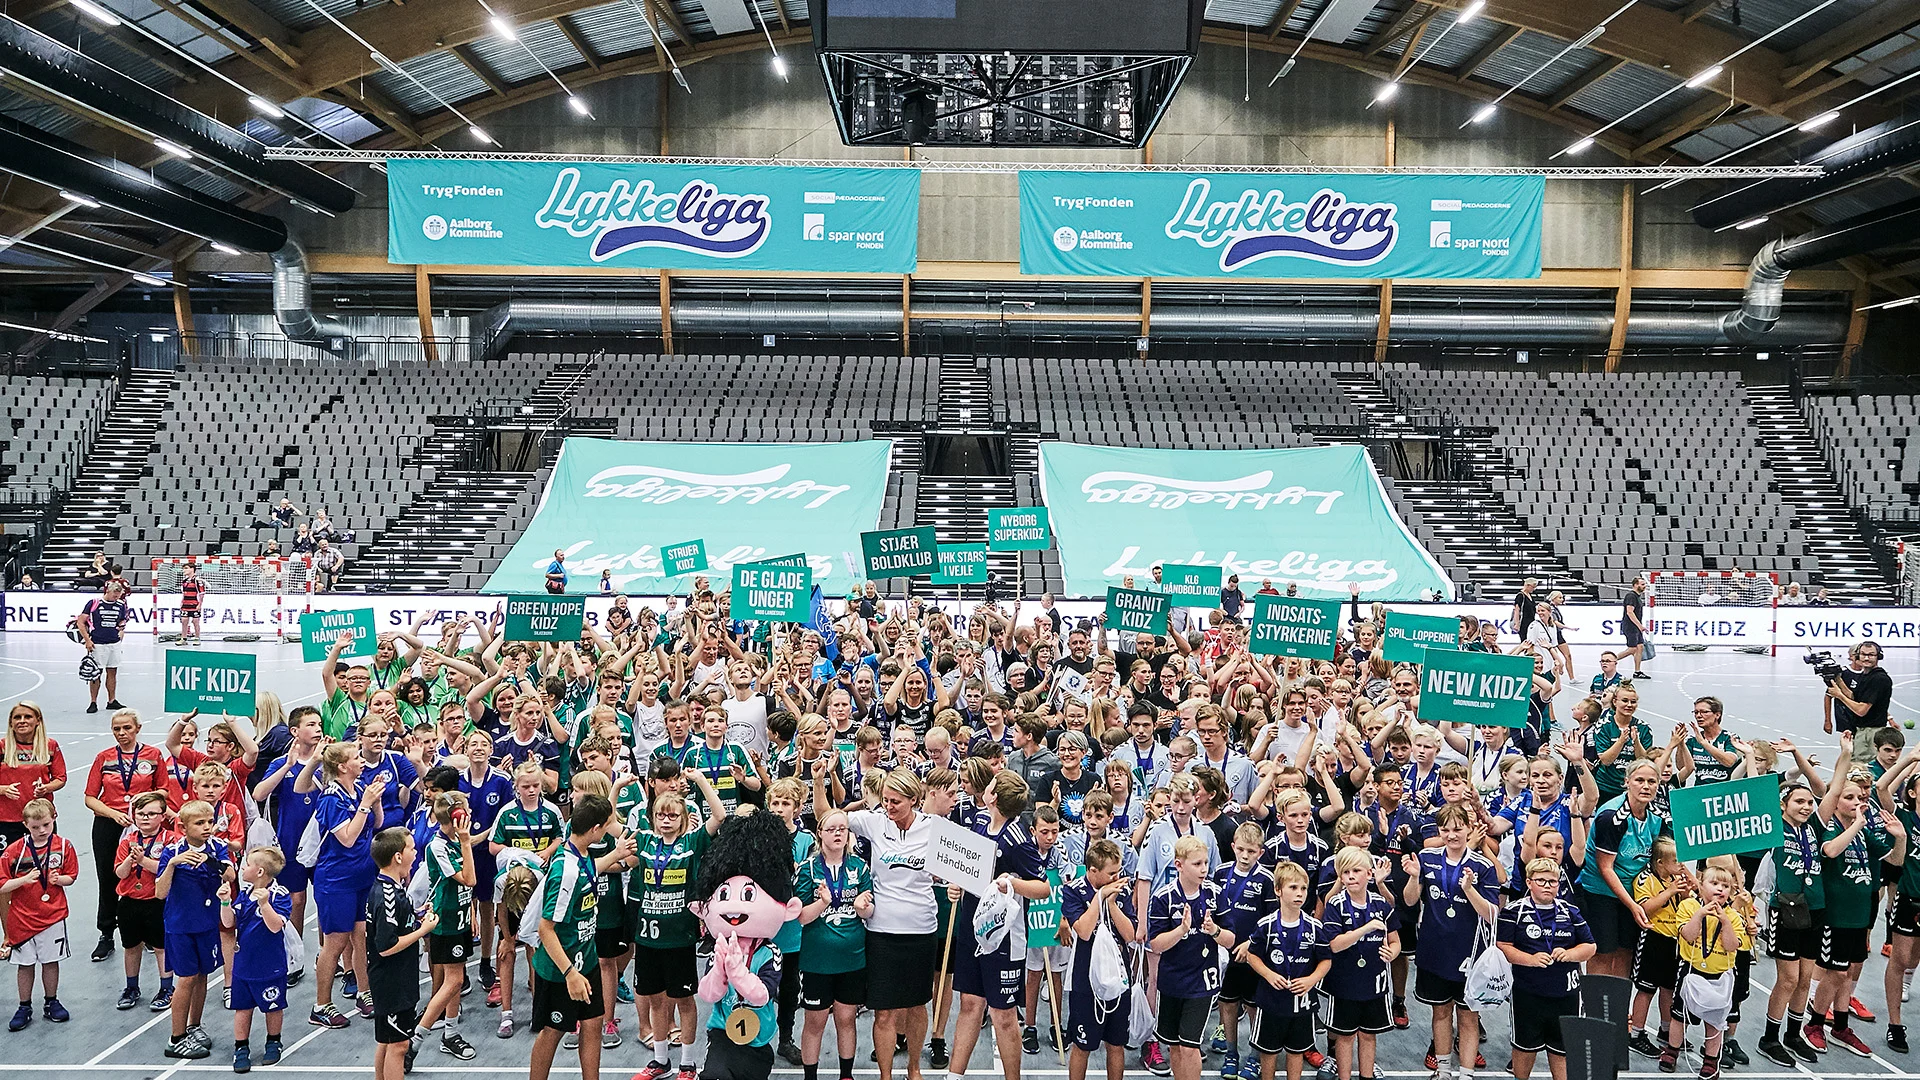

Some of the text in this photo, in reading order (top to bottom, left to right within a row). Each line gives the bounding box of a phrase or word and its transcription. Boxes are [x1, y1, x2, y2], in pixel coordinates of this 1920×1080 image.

[421, 184, 503, 199] TrygFonden
[536, 168, 770, 240] Lykkeliga
[1052, 196, 1134, 210] TrygFonden
[1165, 179, 1399, 247] Lykkeliga
[450, 218, 493, 231] Aalborg
[449, 229, 503, 239] Kommune
[828, 230, 856, 243] spar
[1080, 229, 1123, 242] Aalborg
[1079, 239, 1133, 250] Kommune
[1454, 239, 1482, 251] spar
[1000, 514, 1037, 527] NYBORG
[994, 528, 1045, 541] SUPERKIDZ
[667, 544, 699, 560] STRUER
[879, 535, 919, 553] STJÆR
[675, 558, 696, 572] KIDZ
[870, 551, 933, 571] BOLDKLUB
[957, 550, 985, 563] STARS
[944, 564, 974, 577] I VEJLE
[740, 569, 805, 590] DE GLADE
[1184, 574, 1199, 585] KLG
[1162, 581, 1220, 597] HÅNDBOLD KIDZ
[748, 590, 794, 609] UNGER
[1115, 592, 1165, 613] GRANIT
[221, 607, 265, 625] ALL
[509, 601, 582, 617] GREEN HOPE
[1266, 603, 1327, 625] INDSATS-
[321, 613, 355, 628] VIVILD
[530, 615, 559, 630] KIDZ
[1121, 610, 1153, 630] KIDZ
[1602, 620, 1747, 637] STUER KIDZ
[1255, 623, 1333, 646] STYRKERNE
[1794, 621, 1855, 638] SVHK
[171, 665, 251, 694] KIF KIDZ
[1427, 669, 1529, 701] NEW KIDZ
[1701, 791, 1750, 818] TEAM
[1683, 813, 1773, 847] VILDBJERG
[939, 835, 982, 862] Helsingør
[936, 850, 980, 879] Håndbold
[639, 917, 660, 940] 26
[54, 937, 64, 956] 7
[736, 1019, 746, 1037] 1
